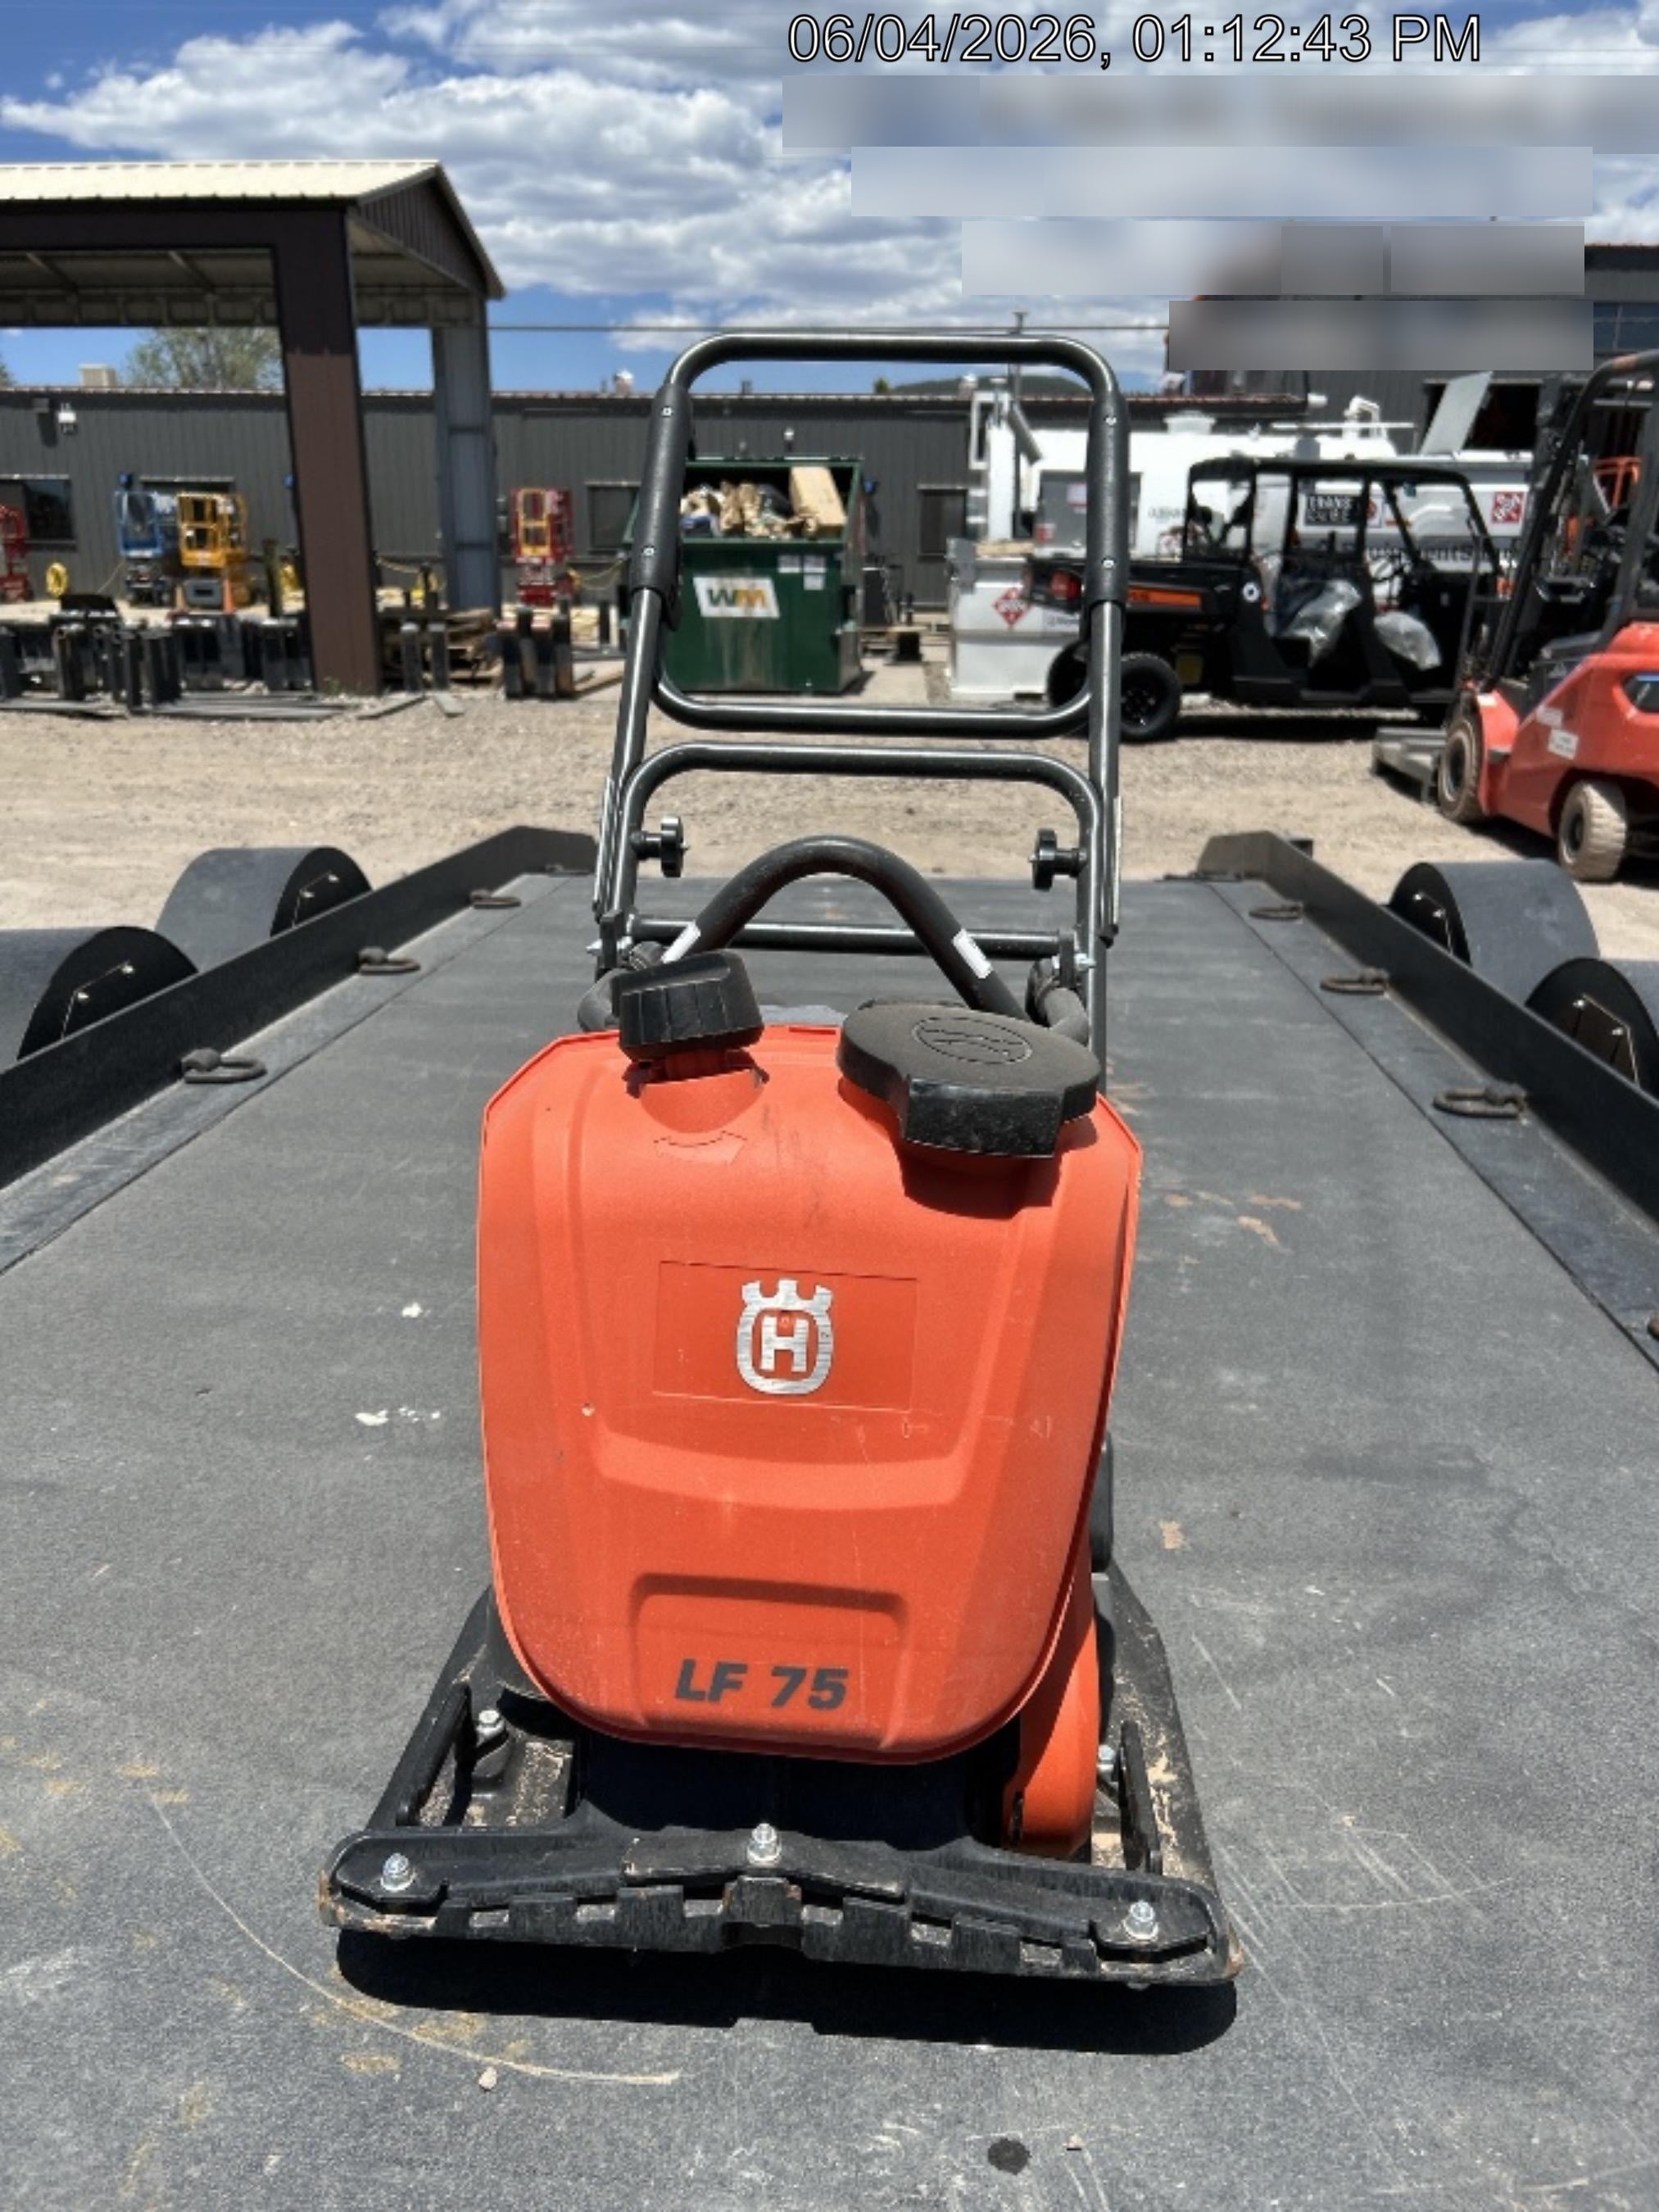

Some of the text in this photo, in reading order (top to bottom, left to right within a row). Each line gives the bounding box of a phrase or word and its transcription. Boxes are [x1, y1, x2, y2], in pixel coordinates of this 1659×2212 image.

[707, 588, 767, 610] WM
[674, 1658, 850, 1711] LF 75
